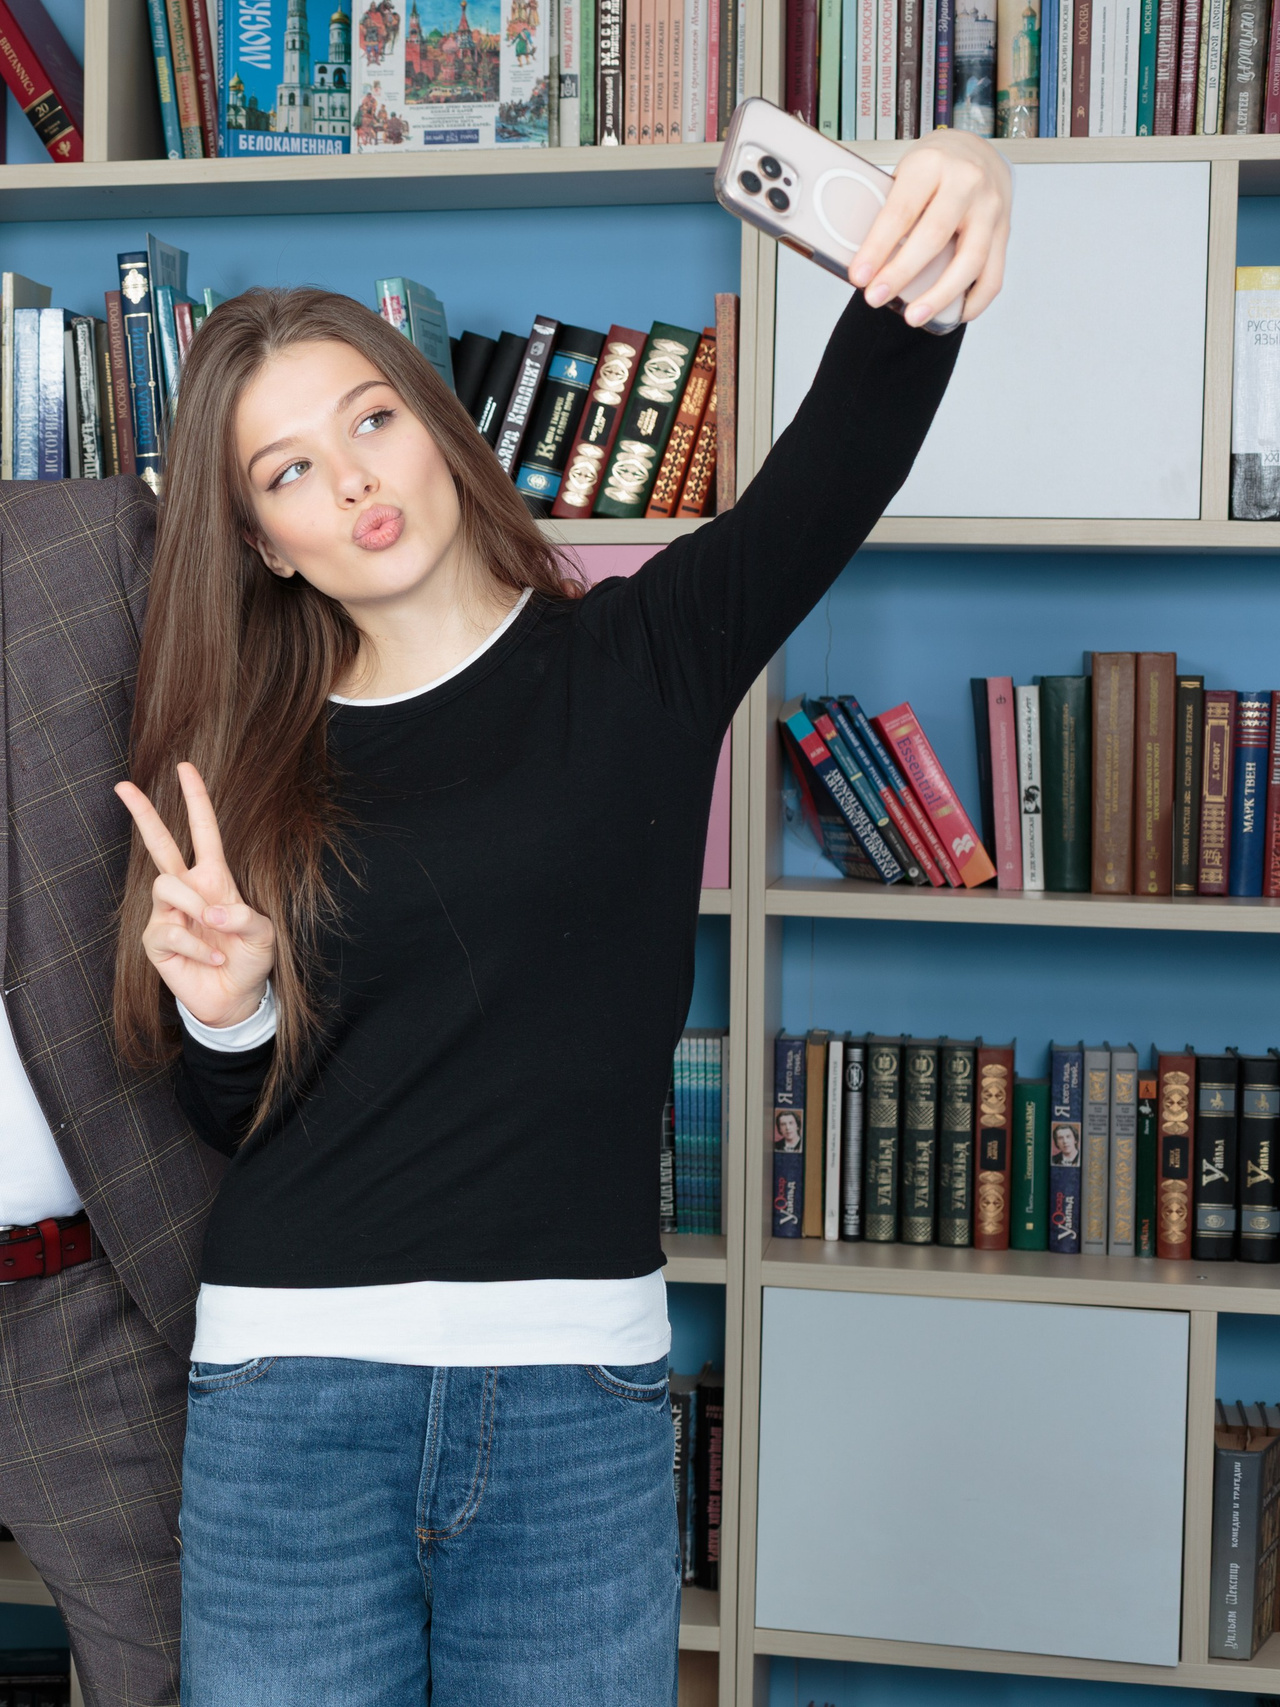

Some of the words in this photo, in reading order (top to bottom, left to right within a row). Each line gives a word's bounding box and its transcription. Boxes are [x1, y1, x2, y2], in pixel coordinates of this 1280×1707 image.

[154, 25, 165, 48] Наш
[1078, 3, 1089, 45] МОСКВА
[1144, 0, 1152, 34] МОСКВА
[195, 21, 205, 55] UNKNOWN
[657, 20, 665, 67] ГОРОЖАНЕ
[1062, 32, 1068, 43] ПО
[1157, 25, 1172, 81] ИСТОРИЯ
[1181, 26, 1197, 82] ИСТОРИЯ
[1209, 36, 1219, 70] СТАРОЙ
[690, 30, 699, 89] средневековой
[862, 66, 872, 88] НАШ
[882, 66, 891, 89] НАШ
[938, 40, 950, 113] МОСКВОВЕДЕНИЕ
[1060, 44, 1068, 86] ЭКСКУРСИИ
[1209, 77, 1216, 89] ПО
[35, 102, 50, 117] 20
[688, 92, 698, 133] Культура
[861, 92, 871, 116] КРАЙ
[881, 92, 891, 117] КРАЙ
[1238, 92, 1249, 126] СЕРГЕЕВ
[238, 134, 343, 155] БЕЛОКАМЕННАЯ
[109, 301, 124, 368] КИТАЙ-ГОРОД
[132, 327, 148, 386] РОССИИ
[118, 378, 128, 419] МОСКВА
[138, 390, 152, 445] ГОРОДА
[18, 413, 33, 476] ИСТОРИЯ
[45, 413, 58, 473] ИСТОРИЯ
[999, 720, 1008, 759] Dictionary
[1106, 734, 1112, 744] OF
[1186, 704, 1194, 743] БЕРЖЕРАК
[1146, 742, 1153, 752] OF
[1185, 746, 1192, 756] ДЕ
[897, 736, 941, 812] Essential
[1146, 753, 1154, 810] CONTEMPORARY
[1244, 762, 1256, 795] ТВЕН
[824, 772, 867, 838] ELEMENTARY
[830, 768, 872, 825] DICTIONARY
[1242, 798, 1255, 834] МАРК
[1003, 794, 1013, 851] English-Russian
[864, 837, 894, 880] OXFORD
[868, 821, 904, 876] LEARNER'S
[1182, 838, 1190, 866] ЭДМОН
[786, 1050, 794, 1070] лишь
[1063, 1062, 1071, 1083] лишь
[778, 1092, 794, 1105] Я
[785, 1070, 793, 1092] всего
[1062, 1083, 1070, 1104] всего
[1025, 1101, 1034, 1145] УИЛЬЯМС
[1055, 1106, 1071, 1118] Я
[877, 1137, 896, 1206] УАЙЛЬД
[914, 1140, 934, 1208] УАЙЛЬД
[951, 1142, 970, 1210] УАЙЛЬД
[1202, 1139, 1229, 1186] Уайльд
[1246, 1140, 1274, 1188] Уайльд
[774, 1177, 788, 1210] Оскар
[779, 1181, 798, 1225] Уайльд
[1052, 1192, 1066, 1225] Оскар
[1057, 1196, 1077, 1240] Уайльд
[708, 1426, 722, 1491] ПРОЩАЛЬНЫЙ
[707, 1495, 720, 1524] ВЗДОХ
[1226, 1563, 1240, 1605] Шекспир
[1224, 1611, 1239, 1650] Уильям
